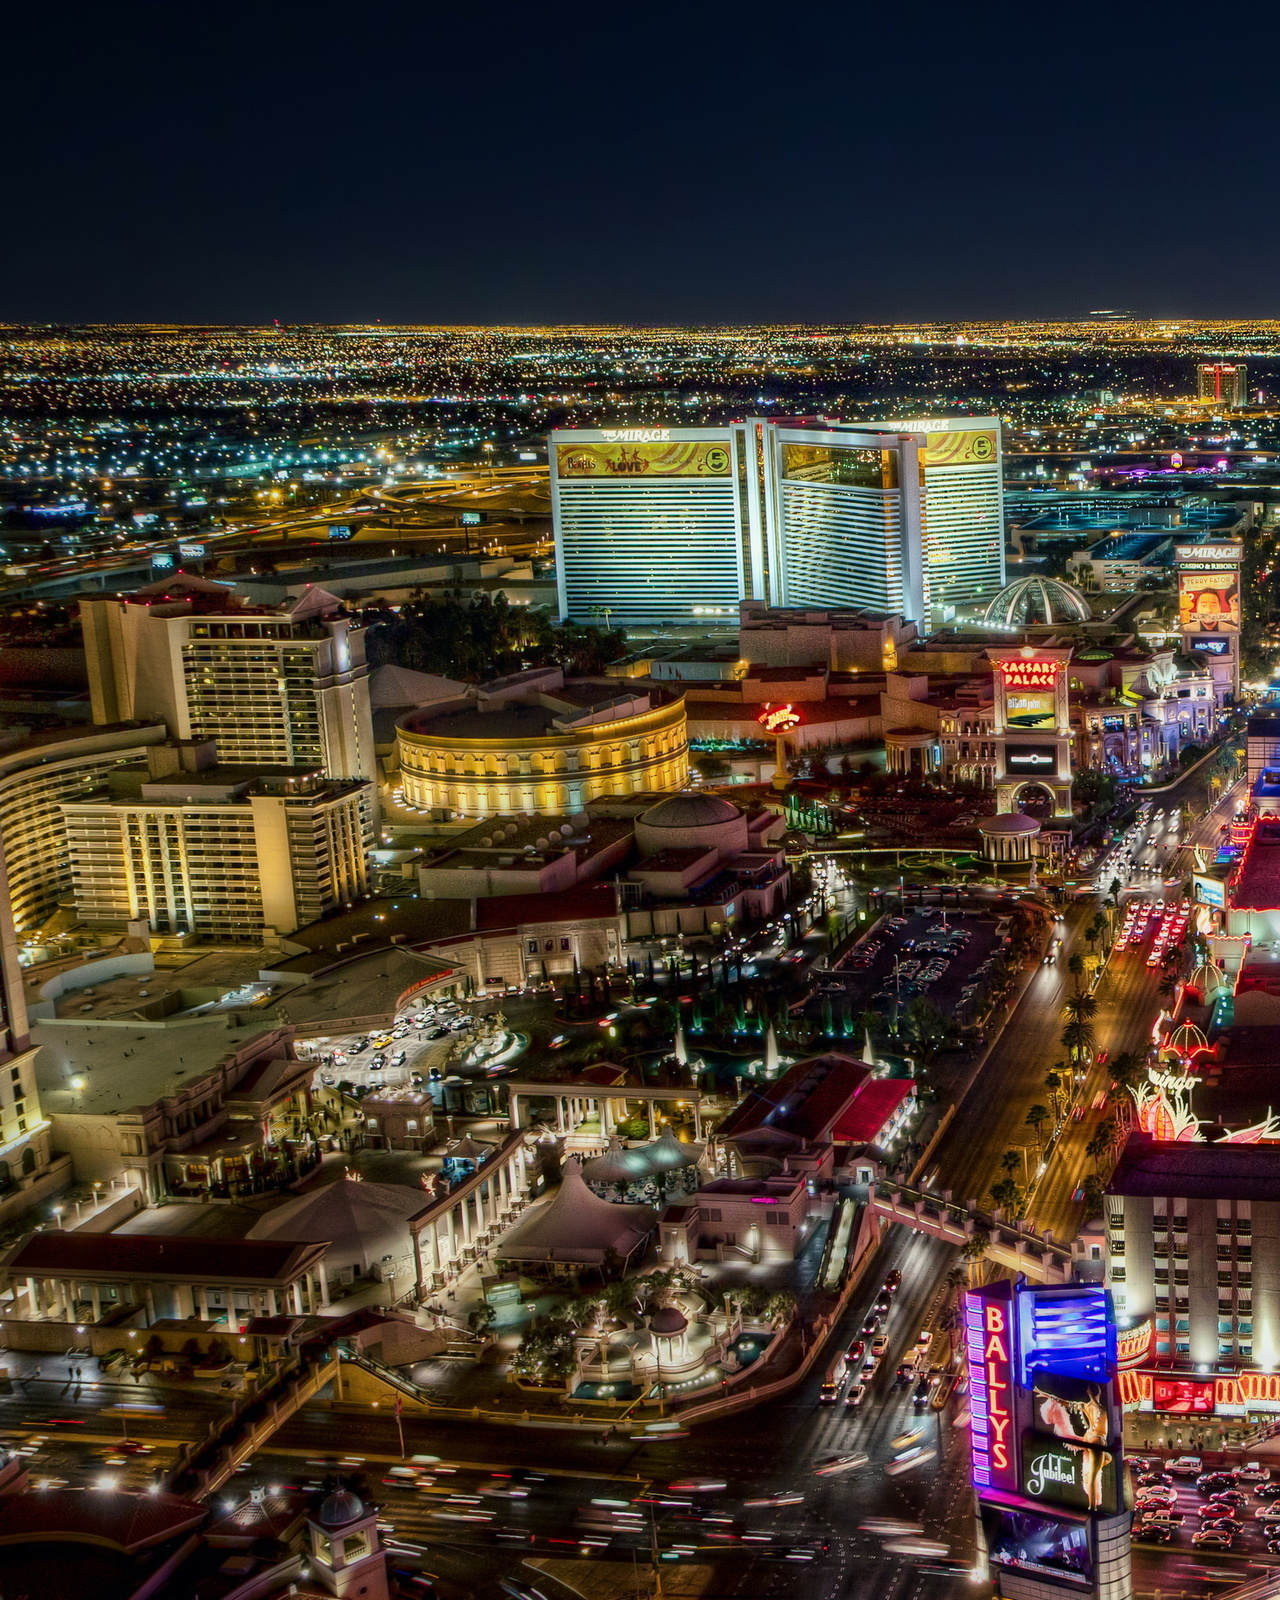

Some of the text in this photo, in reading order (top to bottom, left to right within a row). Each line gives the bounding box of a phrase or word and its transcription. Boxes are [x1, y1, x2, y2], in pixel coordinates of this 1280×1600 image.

[902, 420, 949, 433] MIRAGE
[612, 430, 670, 443] MIRAGE
[977, 441, 988, 455] 5
[711, 452, 724, 469] 5
[611, 461, 642, 473] LOVE
[1184, 548, 1240, 559] MIRAGE
[1001, 662, 1057, 673] CAESARS
[1005, 675, 1055, 685] PALACE
[1008, 697, 1027, 709] elton
[1027, 1453, 1076, 1496] Jubilee!
